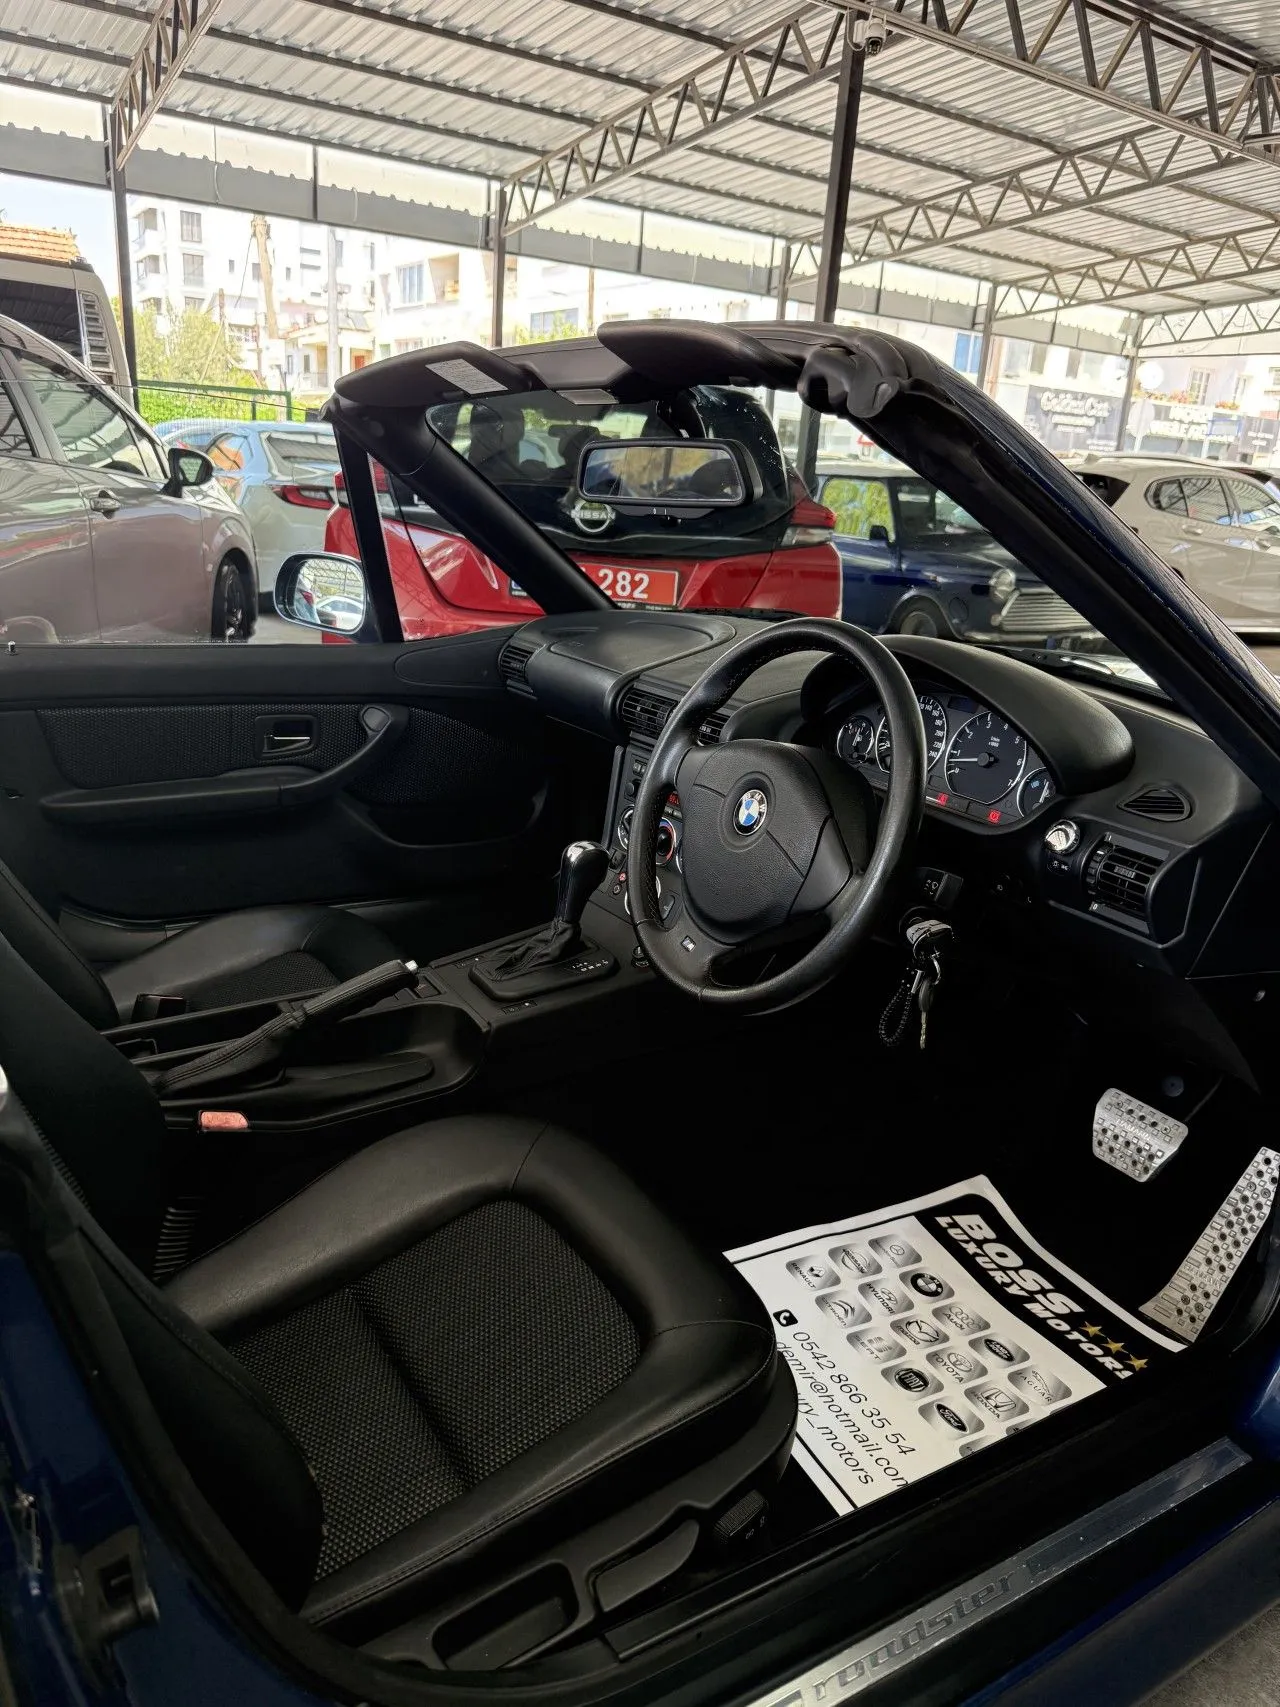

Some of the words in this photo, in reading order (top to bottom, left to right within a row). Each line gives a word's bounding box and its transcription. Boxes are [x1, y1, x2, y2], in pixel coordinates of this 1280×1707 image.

[571, 509, 616, 520] NISSAN
[598, 568, 650, 599] 282
[934, 1216, 1030, 1297] LUXURY
[951, 1214, 1085, 1315] BOSS
[791, 1262, 816, 1289] RENAULT
[866, 1283, 896, 1314] HYUNDAI
[901, 1372, 924, 1388] FIAT
[933, 1353, 963, 1383] TOYOTA
[793, 1332, 836, 1371] 0542
[830, 1374, 868, 1404] 866
[862, 1407, 892, 1429] 35
[885, 1433, 916, 1456] 54
[1018, 1372, 1052, 1402] JAGUAR
[940, 1409, 961, 1427] Ford
